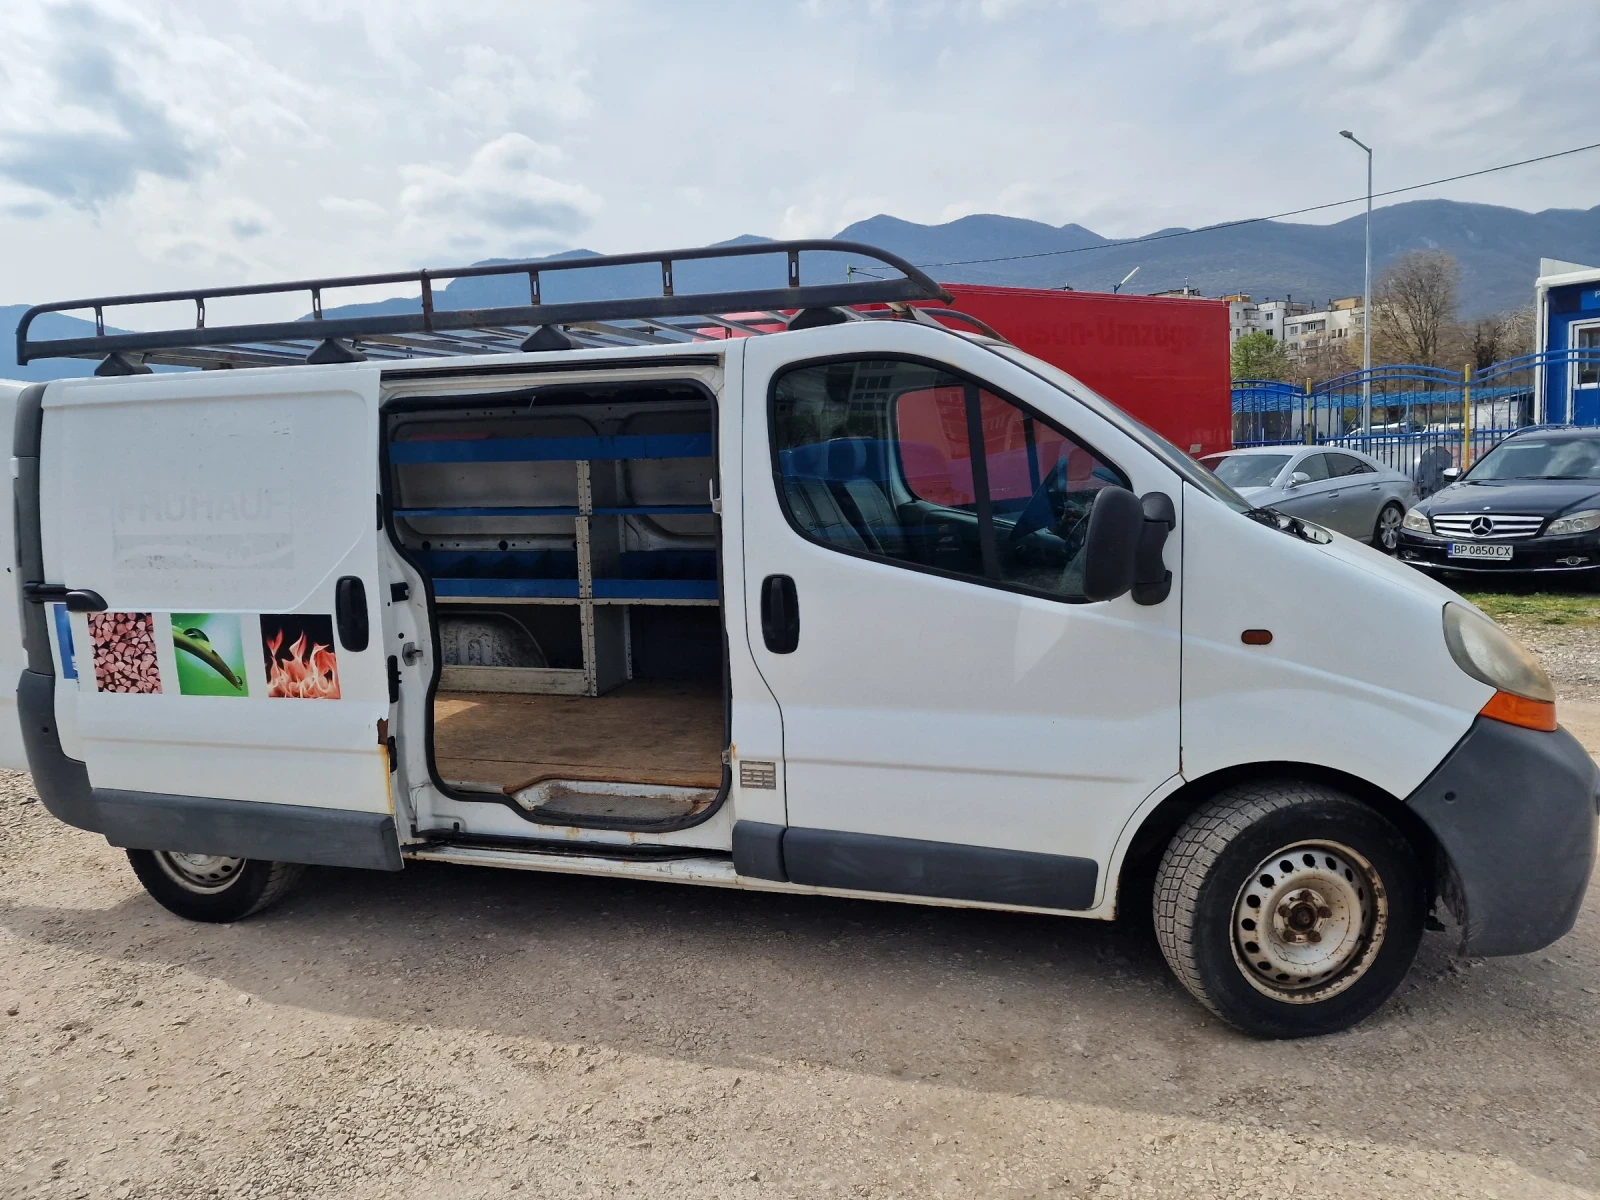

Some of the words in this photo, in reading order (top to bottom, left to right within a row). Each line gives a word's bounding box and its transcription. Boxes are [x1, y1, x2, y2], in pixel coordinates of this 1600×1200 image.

[1454, 545, 1468, 555] BP
[1469, 545, 1495, 556] 0850
[1496, 546, 1511, 556] CX
